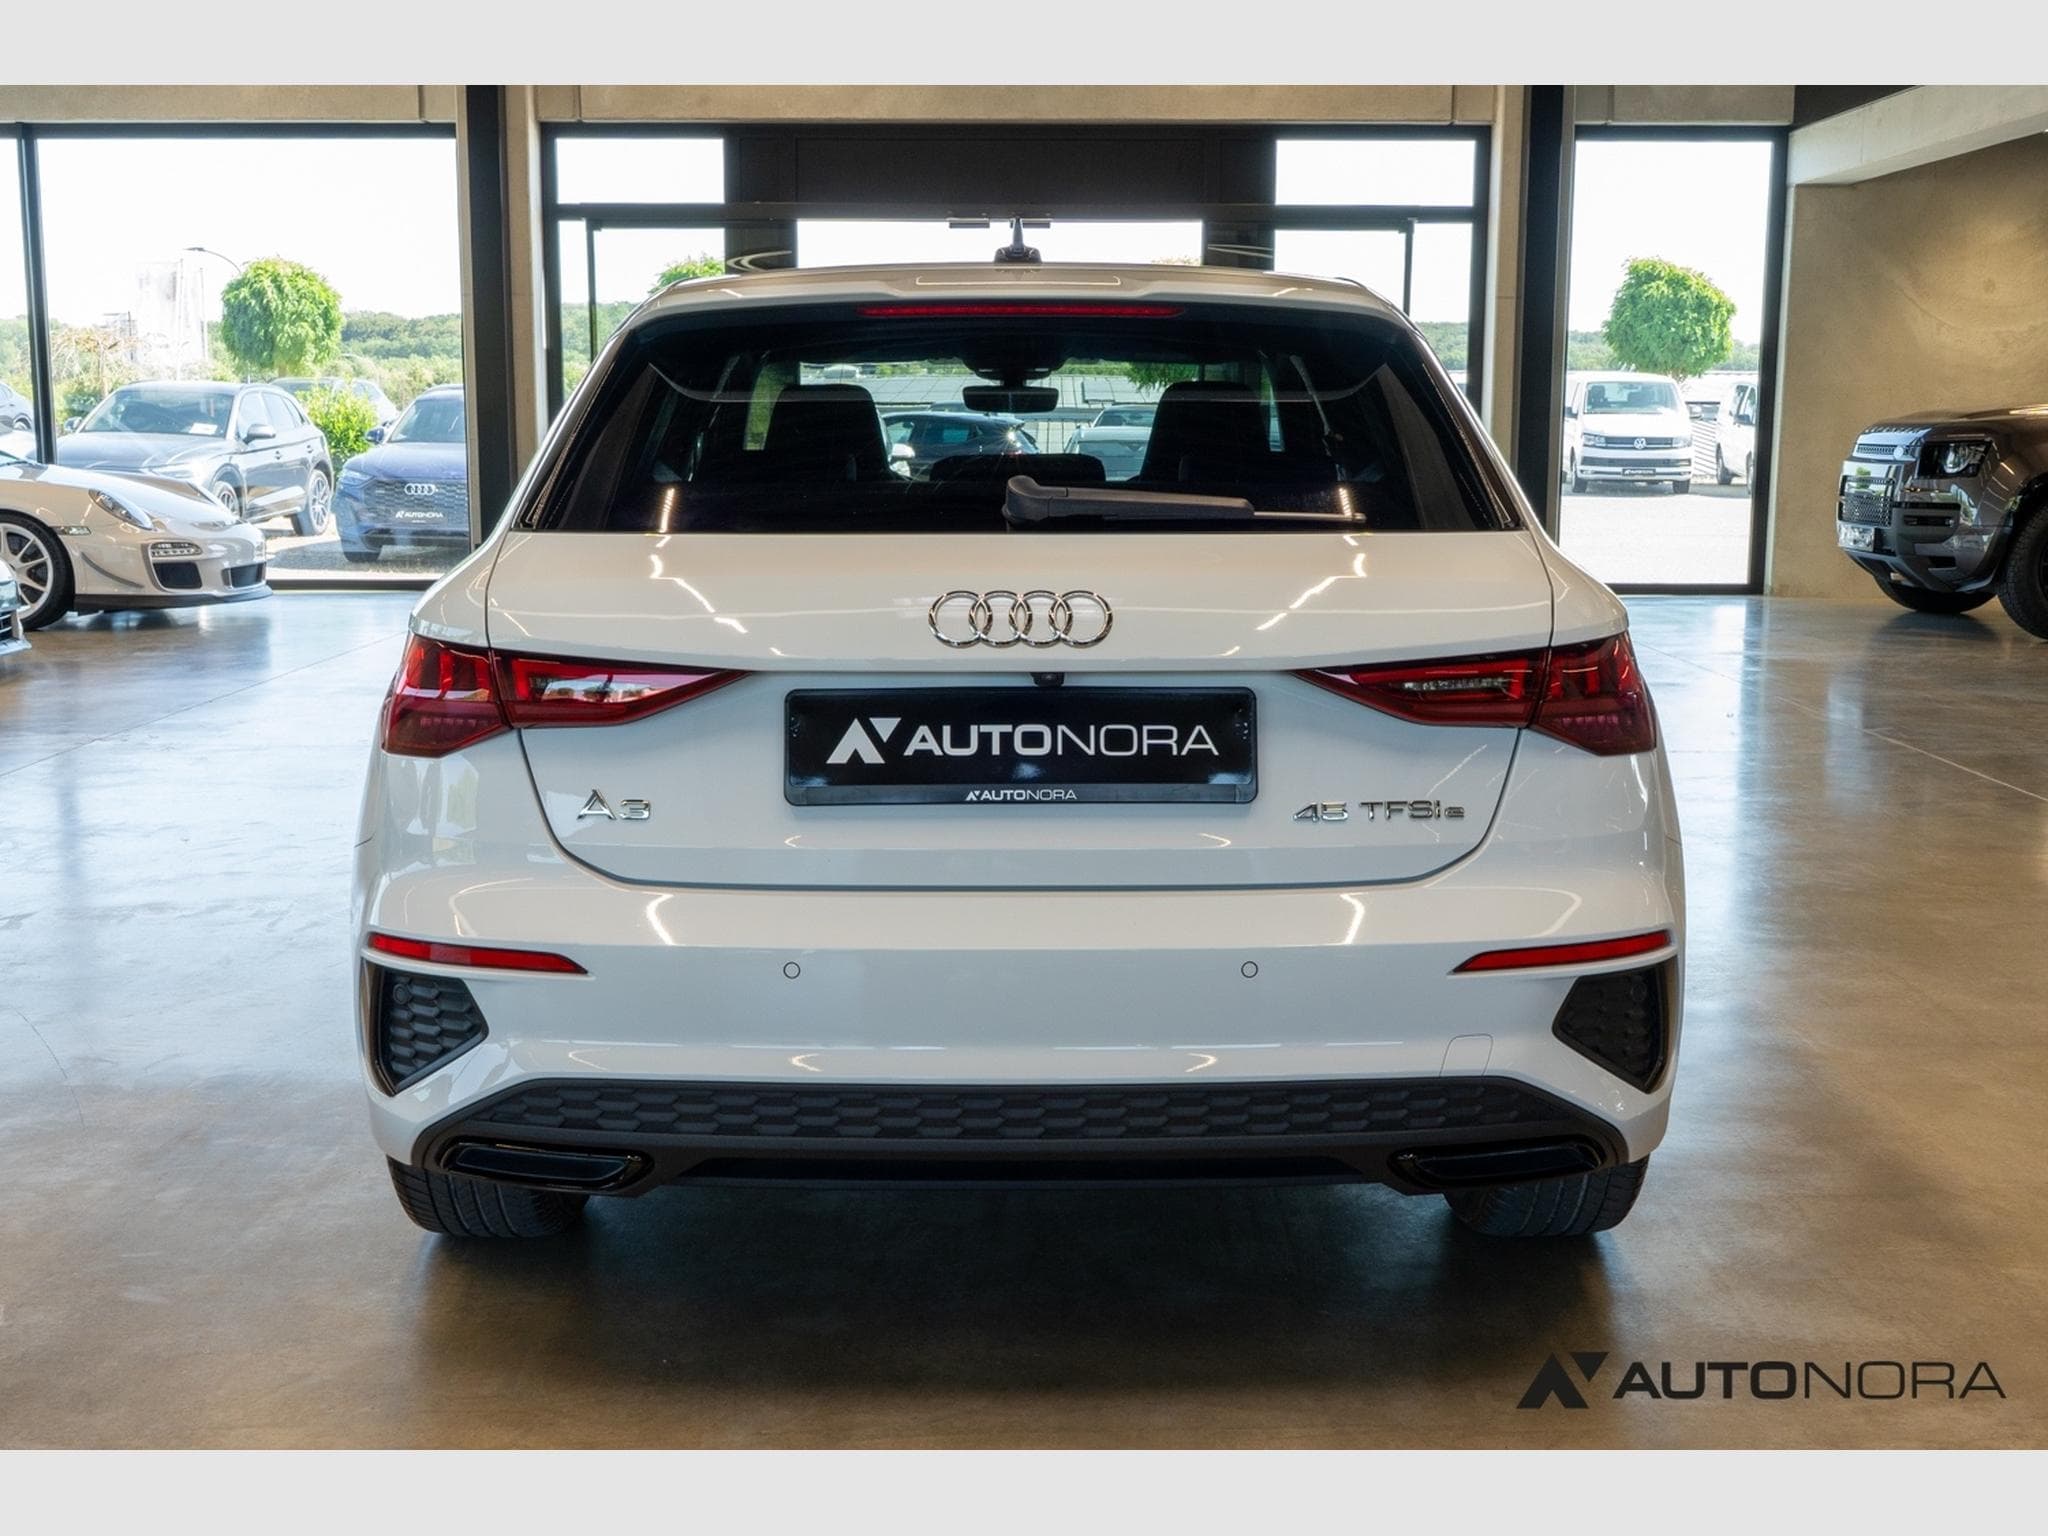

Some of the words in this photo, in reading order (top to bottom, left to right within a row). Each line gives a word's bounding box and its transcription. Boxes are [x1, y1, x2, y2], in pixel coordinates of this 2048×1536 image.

[903, 724, 1219, 757] AUTONORA
[577, 789, 650, 821] A3
[980, 789, 1078, 801] AUTONORA
[1293, 800, 1349, 822] 45
